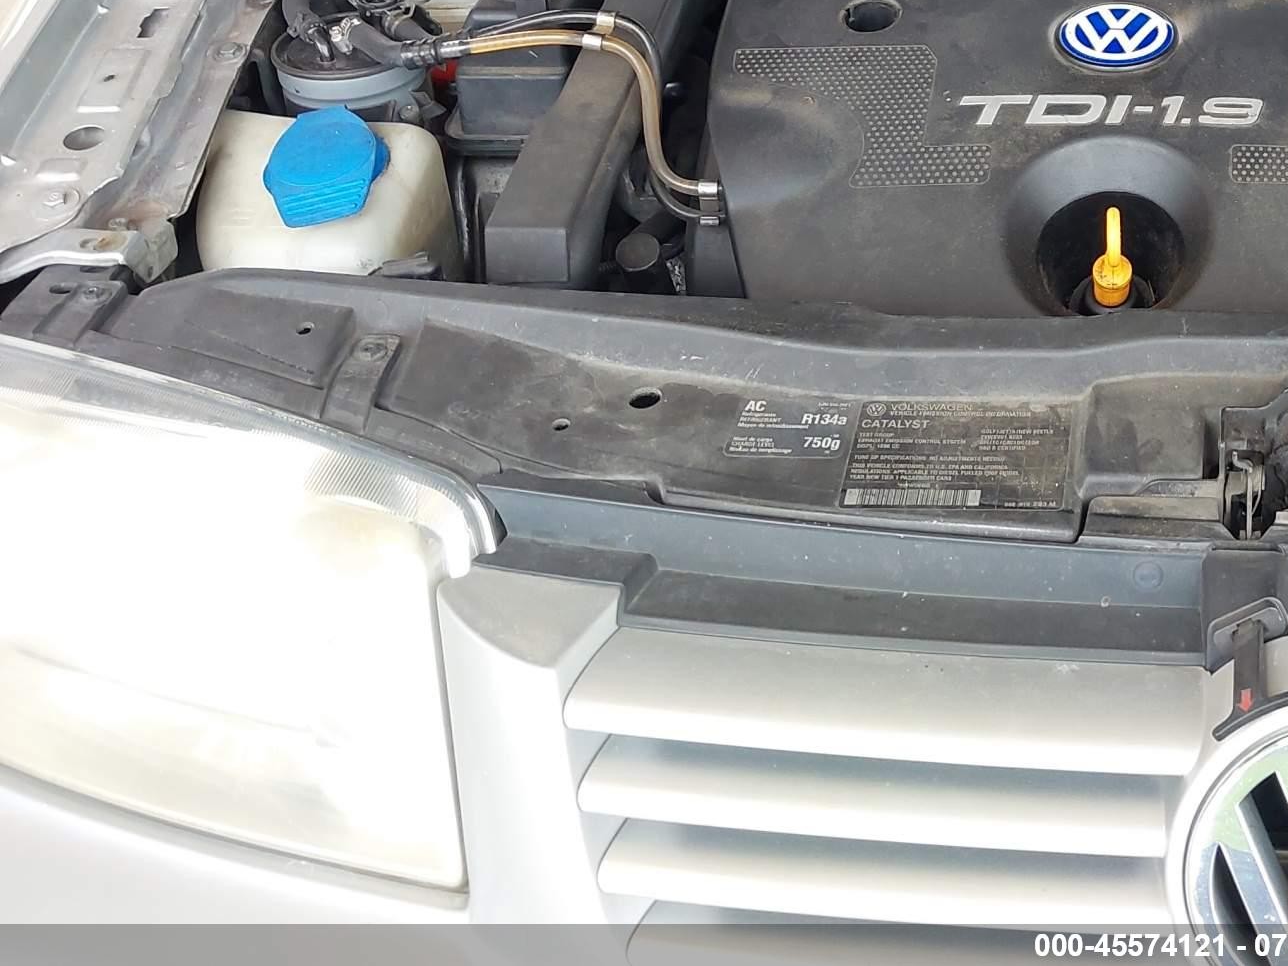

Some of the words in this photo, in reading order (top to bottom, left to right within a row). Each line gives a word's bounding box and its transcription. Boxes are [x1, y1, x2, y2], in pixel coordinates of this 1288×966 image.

[959, 94, 1264, 126] TDI-1.9
[744, 400, 768, 412] AC
[891, 402, 974, 412] VOLKSWAGEN
[801, 413, 848, 425] R134a
[861, 419, 931, 429] CATALYST
[803, 436, 841, 451] 750g
